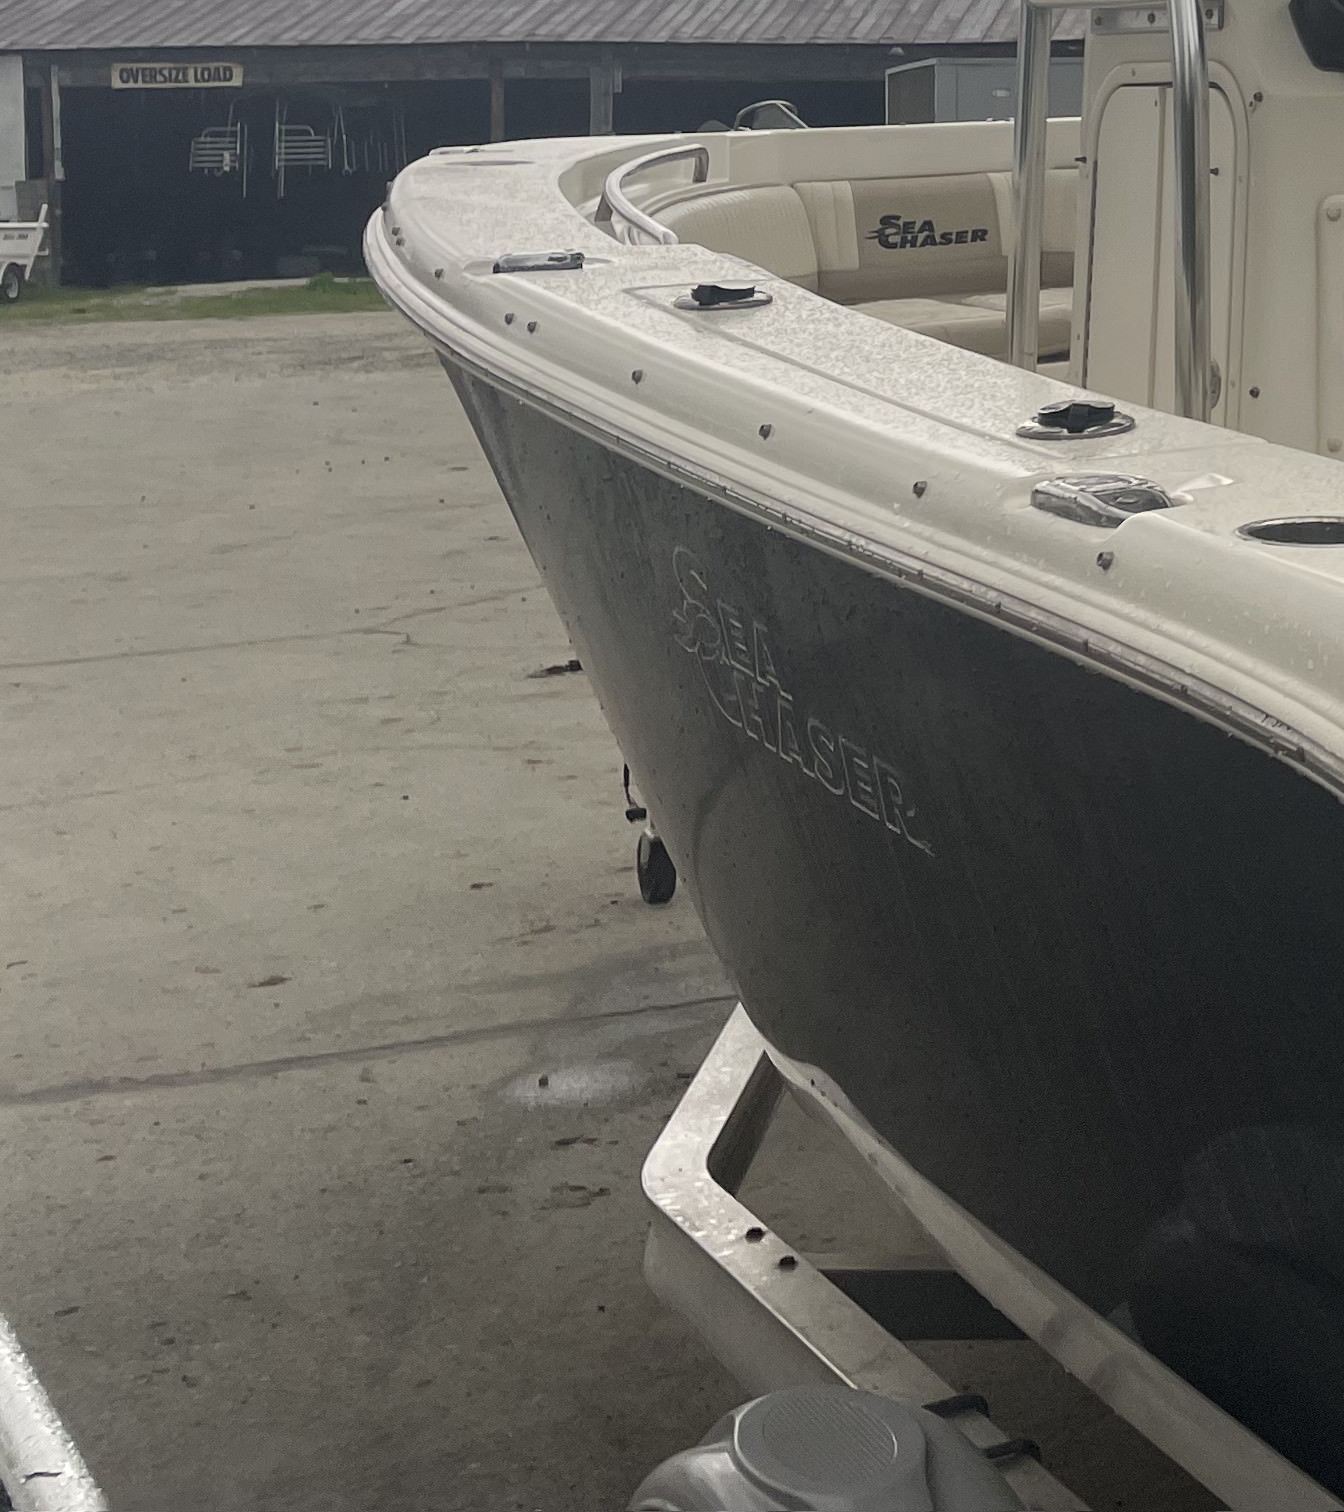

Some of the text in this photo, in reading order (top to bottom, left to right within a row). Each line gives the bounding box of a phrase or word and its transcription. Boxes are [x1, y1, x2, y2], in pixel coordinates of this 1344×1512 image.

[119, 64, 234, 85] OVERSIZE LOAD
[879, 215, 936, 235] SEA
[877, 227, 989, 249] CHASER
[671, 544, 784, 689] SEA
[694, 628, 934, 857] CHASER
